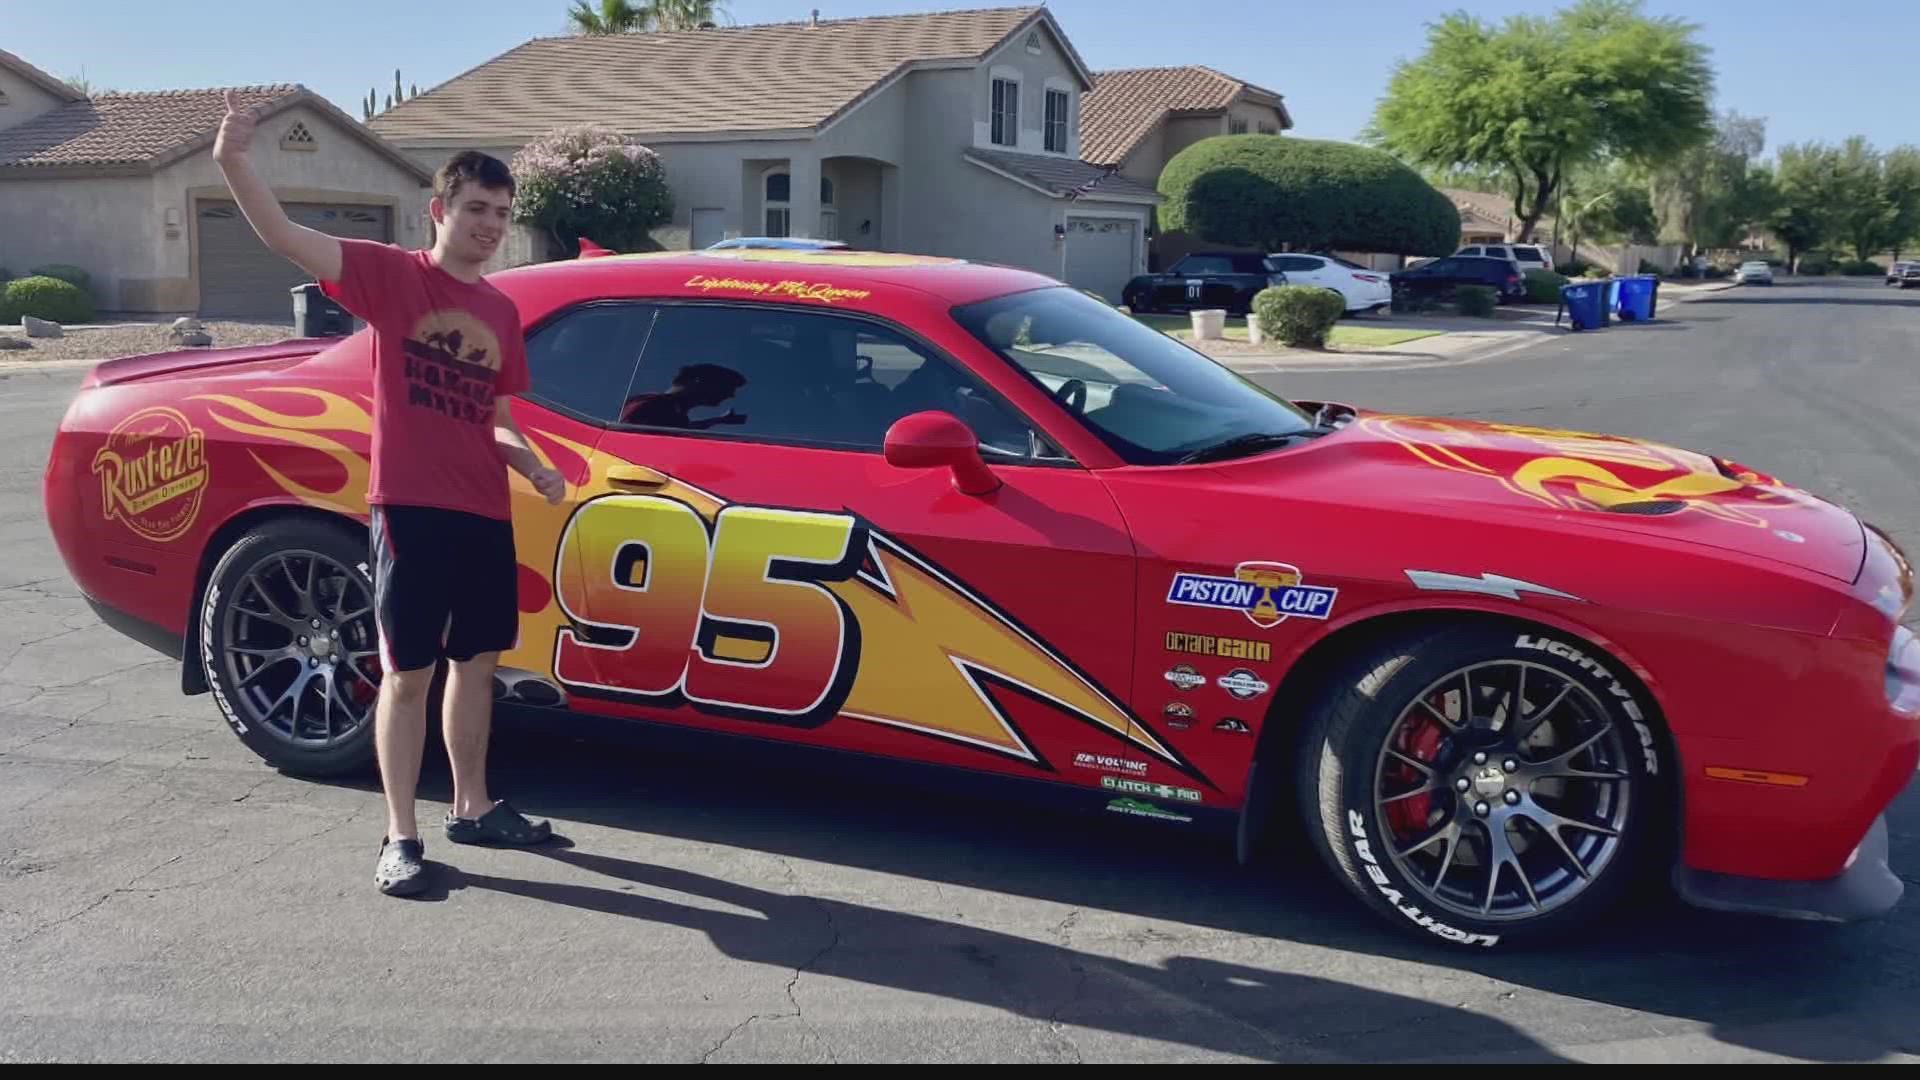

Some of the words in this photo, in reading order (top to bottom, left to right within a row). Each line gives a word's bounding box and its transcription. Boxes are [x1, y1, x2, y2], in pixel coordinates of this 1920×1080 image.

[684, 275, 770, 296] Lightning
[770, 280, 871, 302] McQueen
[1188, 286, 1201, 298] 01
[553, 493, 857, 720] 95
[1176, 578, 1256, 607] PISTON
[1280, 589, 1329, 613] CUP
[1515, 634, 1658, 776] LIGHTYEAR
[1103, 777, 1151, 793] CLUTCH
[1349, 809, 1500, 947] LIGHTYEAR
